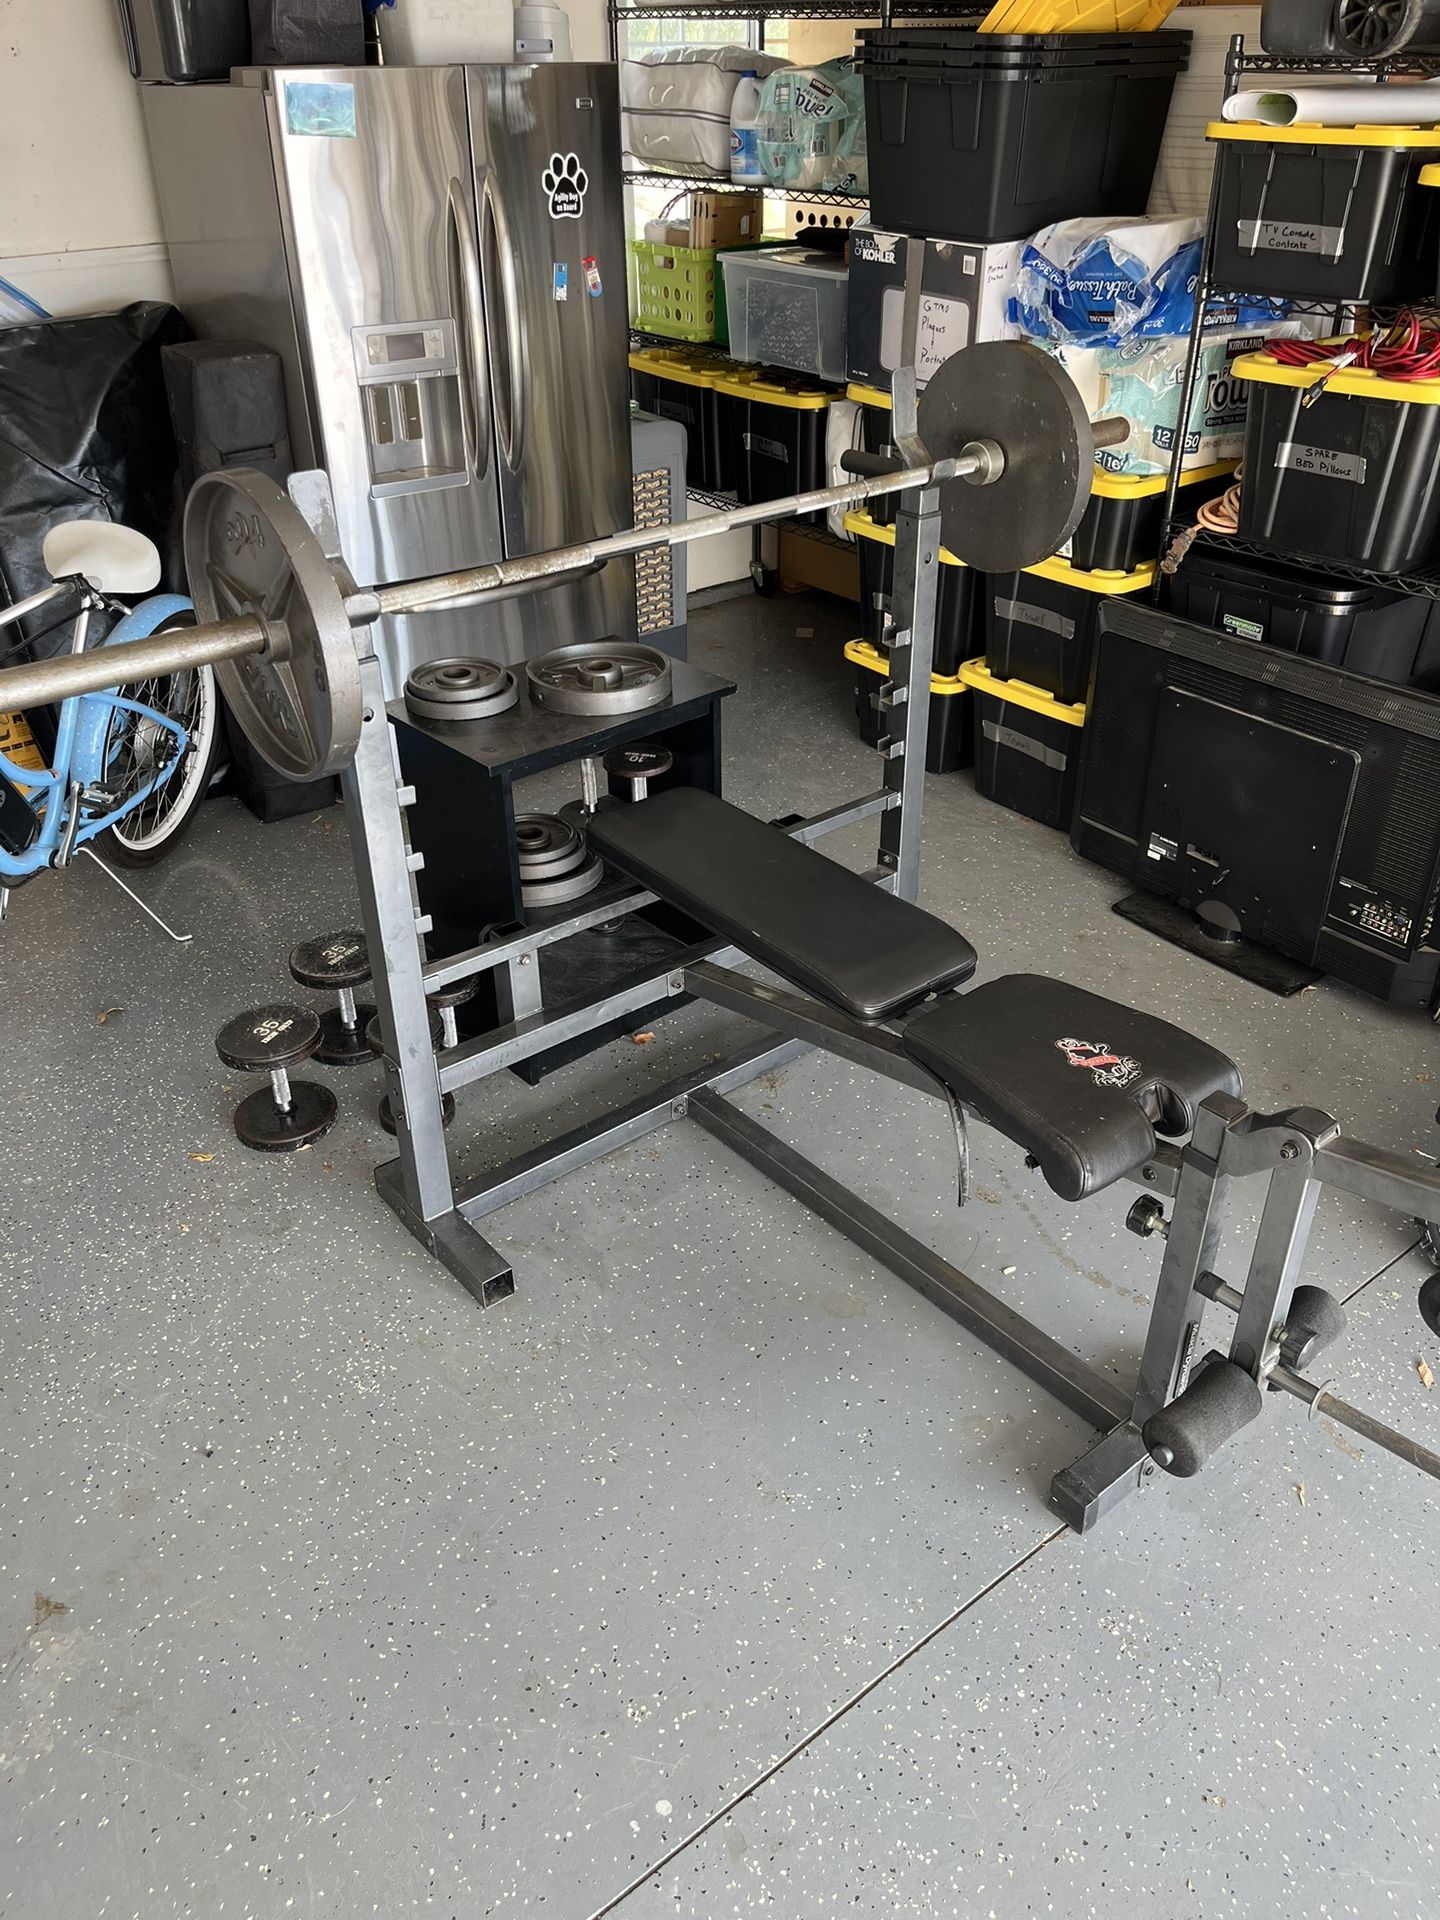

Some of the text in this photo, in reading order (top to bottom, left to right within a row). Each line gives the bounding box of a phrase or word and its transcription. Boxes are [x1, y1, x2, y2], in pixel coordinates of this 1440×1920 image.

[1282, 226, 1317, 240] Console
[855, 238, 865, 248] THE
[1268, 238, 1308, 250] Contents
[854, 247, 862, 256] OF
[1069, 278, 1136, 301] Bath Tissue
[921, 316, 946, 335] Plaques
[1228, 338, 1263, 351] KIRKLAND
[1204, 373, 1250, 415] Tow
[1155, 428, 1171, 443] 12
[1184, 434, 1199, 448] 60
[1305, 448, 1339, 461] SPARE
[1296, 458, 1352, 476] BED Pillows
[629, 755, 644, 763] 10
[322, 944, 346, 959] 35
[253, 1020, 279, 1036] 35
[260, 1019, 294, 1044] IRON GRIP
